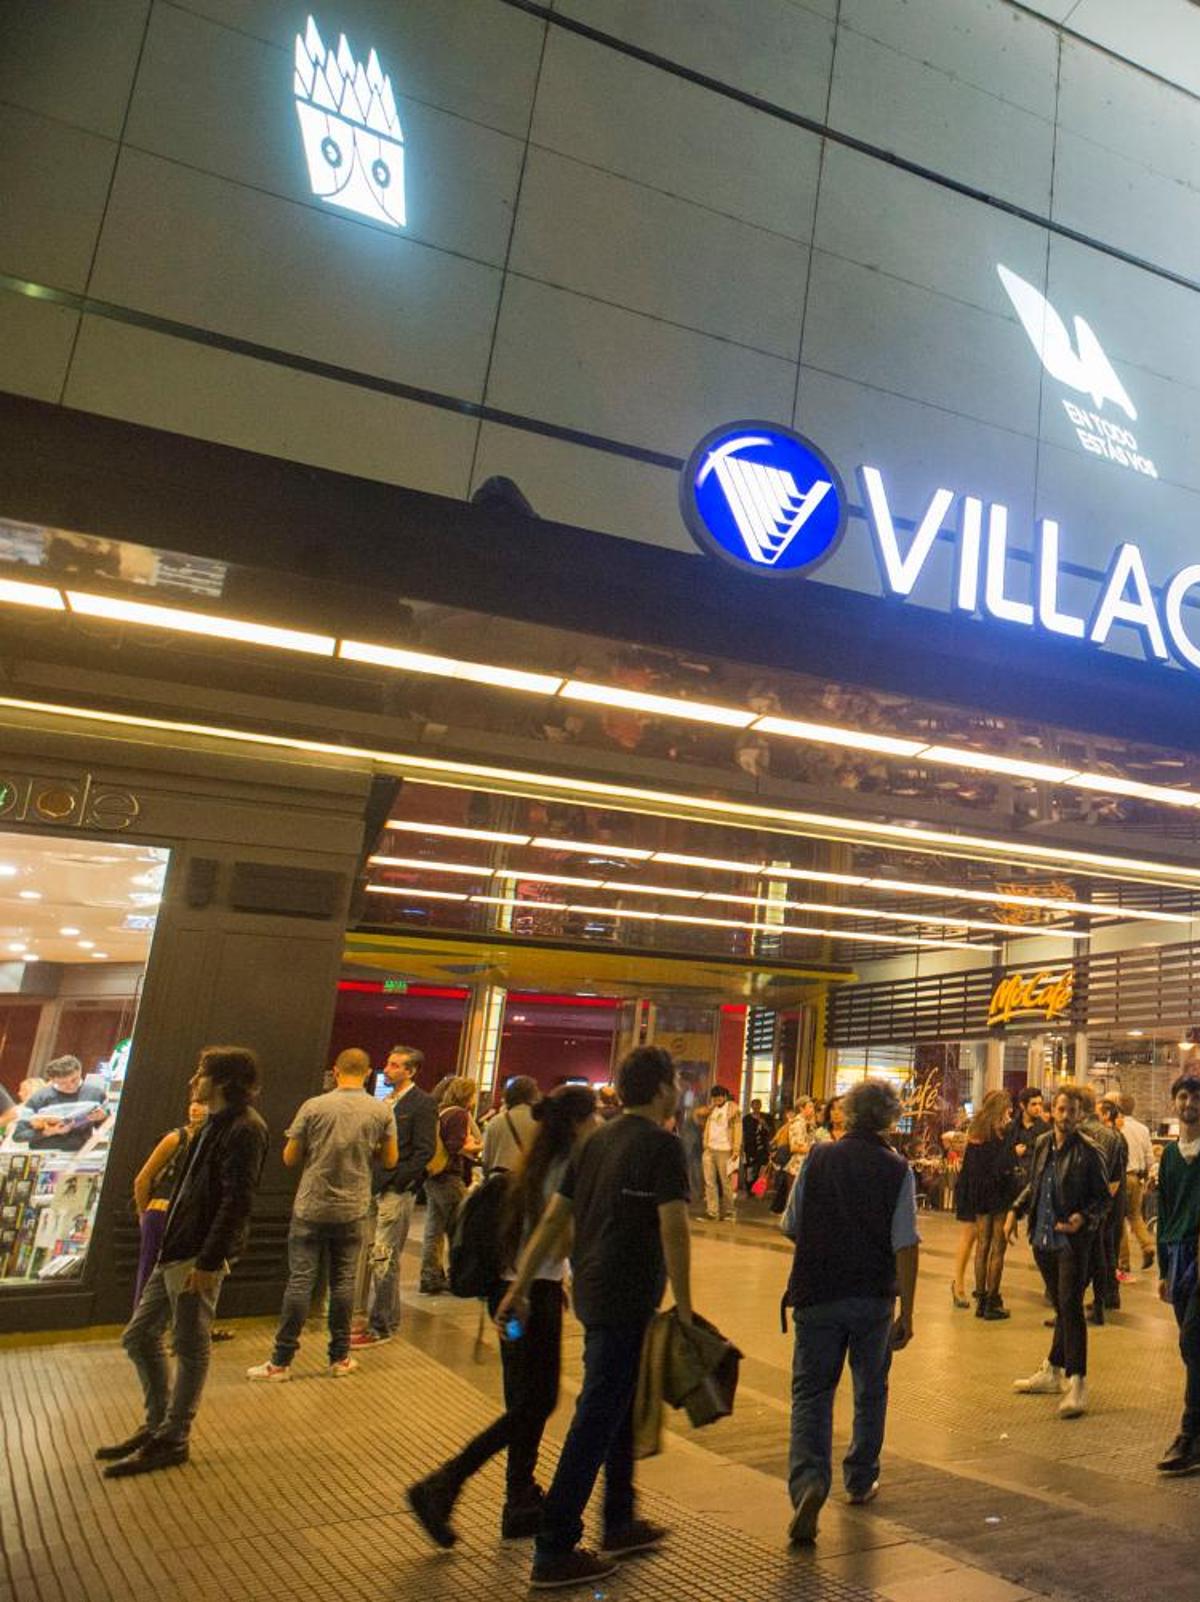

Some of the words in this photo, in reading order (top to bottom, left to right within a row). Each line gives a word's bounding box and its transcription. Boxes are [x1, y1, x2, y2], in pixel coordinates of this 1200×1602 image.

[1062, 399, 1094, 431] EN
[1089, 412, 1138, 452] TODO
[987, 968, 1075, 1026] McCafé
